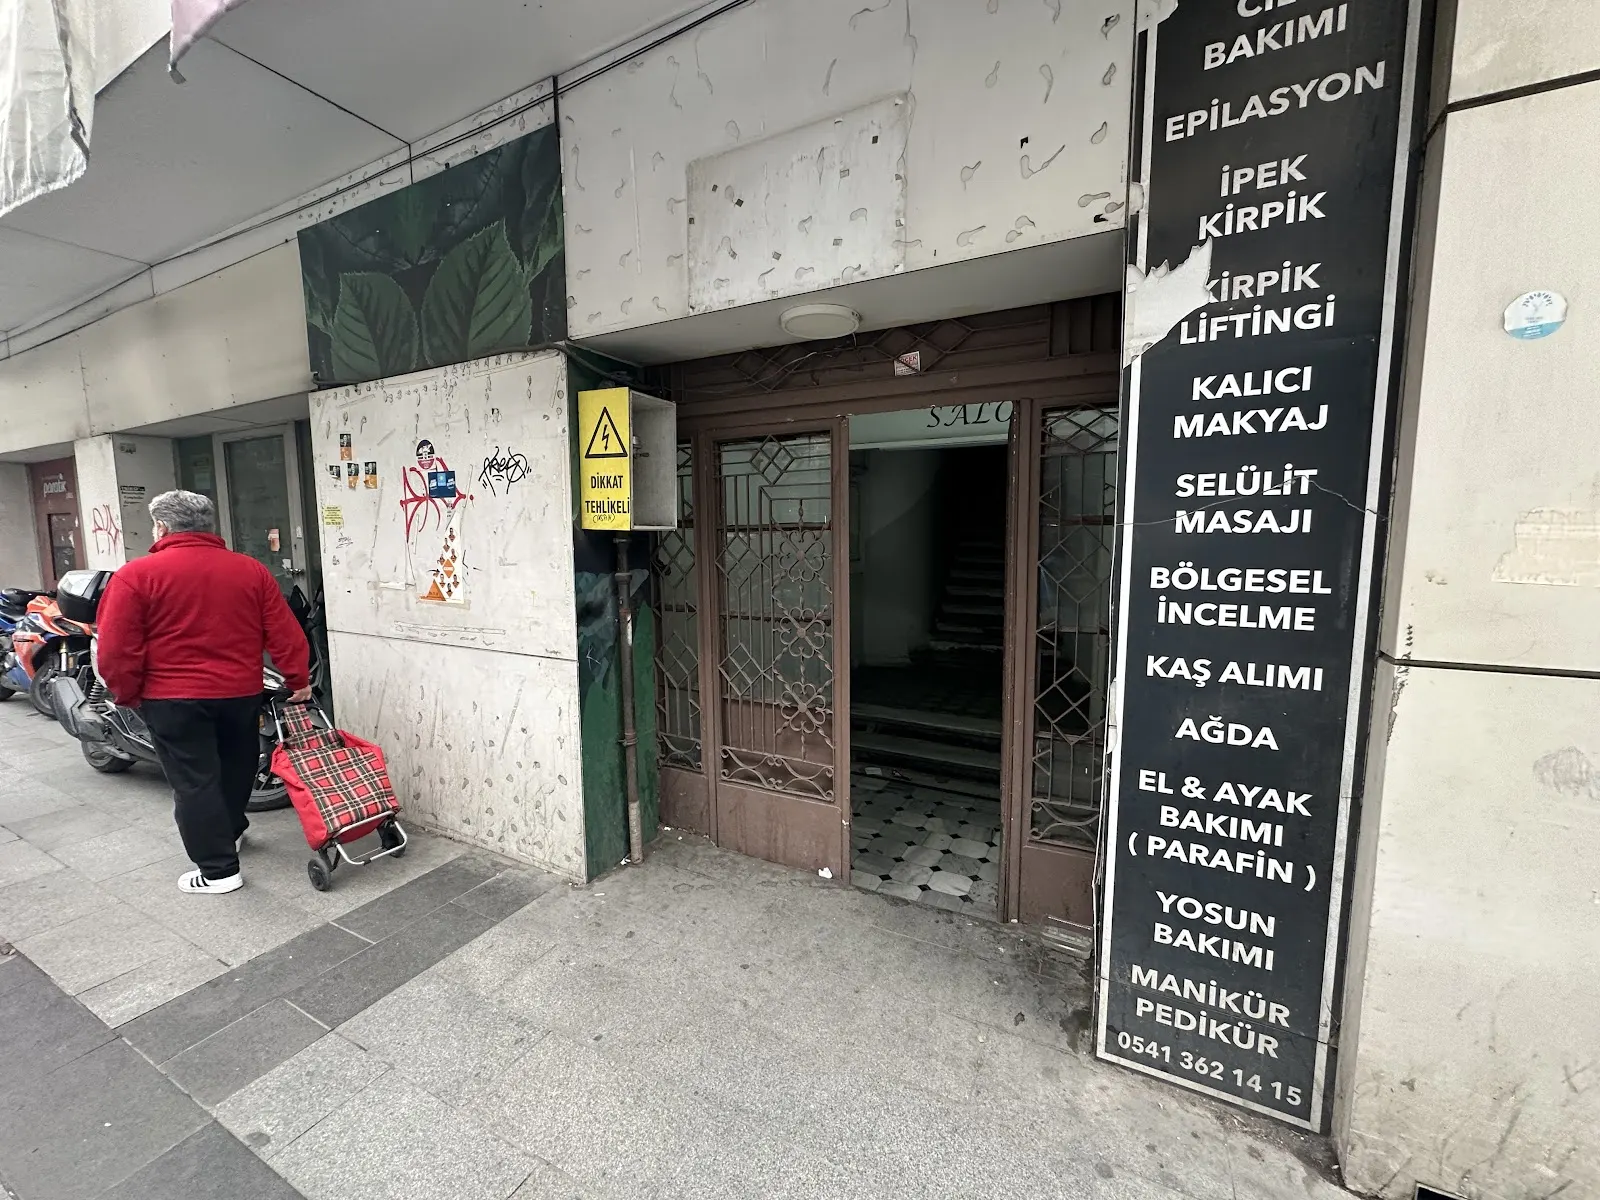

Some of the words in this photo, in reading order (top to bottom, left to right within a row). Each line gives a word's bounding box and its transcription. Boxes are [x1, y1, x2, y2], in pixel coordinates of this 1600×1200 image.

[1203, 3, 1347, 70] BAKIMI
[1165, 61, 1385, 142] EPİLASYON
[1220, 154, 1308, 197] İPEK
[1198, 190, 1327, 240] KİRPİK
[1179, 294, 1336, 345] LİFTİNGİ
[1192, 366, 1312, 401] KALICI
[1173, 405, 1329, 438] MAKYAJ
[591, 472, 623, 489] DİKKAT
[1175, 463, 1318, 497] SELÜLİT
[585, 497, 630, 514] TEHLİKELİ
[1174, 509, 1312, 534] MASAJI
[1150, 561, 1332, 594] BÖLGESEL
[1157, 595, 1316, 631] İNCELME
[1146, 655, 1212, 687] KAŞ
[1218, 661, 1323, 691] ALIMI
[1175, 715, 1279, 750] AĞDA
[1138, 769, 1173, 795] EL
[1181, 776, 1206, 800] &
[1213, 782, 1313, 817] AYAK
[1159, 805, 1284, 847] BAKIMI
[1147, 835, 1293, 884] PARAFİN
[1155, 891, 1275, 938] YOSUN
[1153, 922, 1275, 971] BAKIMI
[1131, 964, 1290, 1028] MANİKÜR
[1136, 997, 1279, 1059] PEDİKÜR
[1117, 1031, 1171, 1063] 0541
[1179, 1051, 1225, 1081] 362
[1232, 1068, 1262, 1093] 14
[1270, 1081, 1302, 1106] 15
